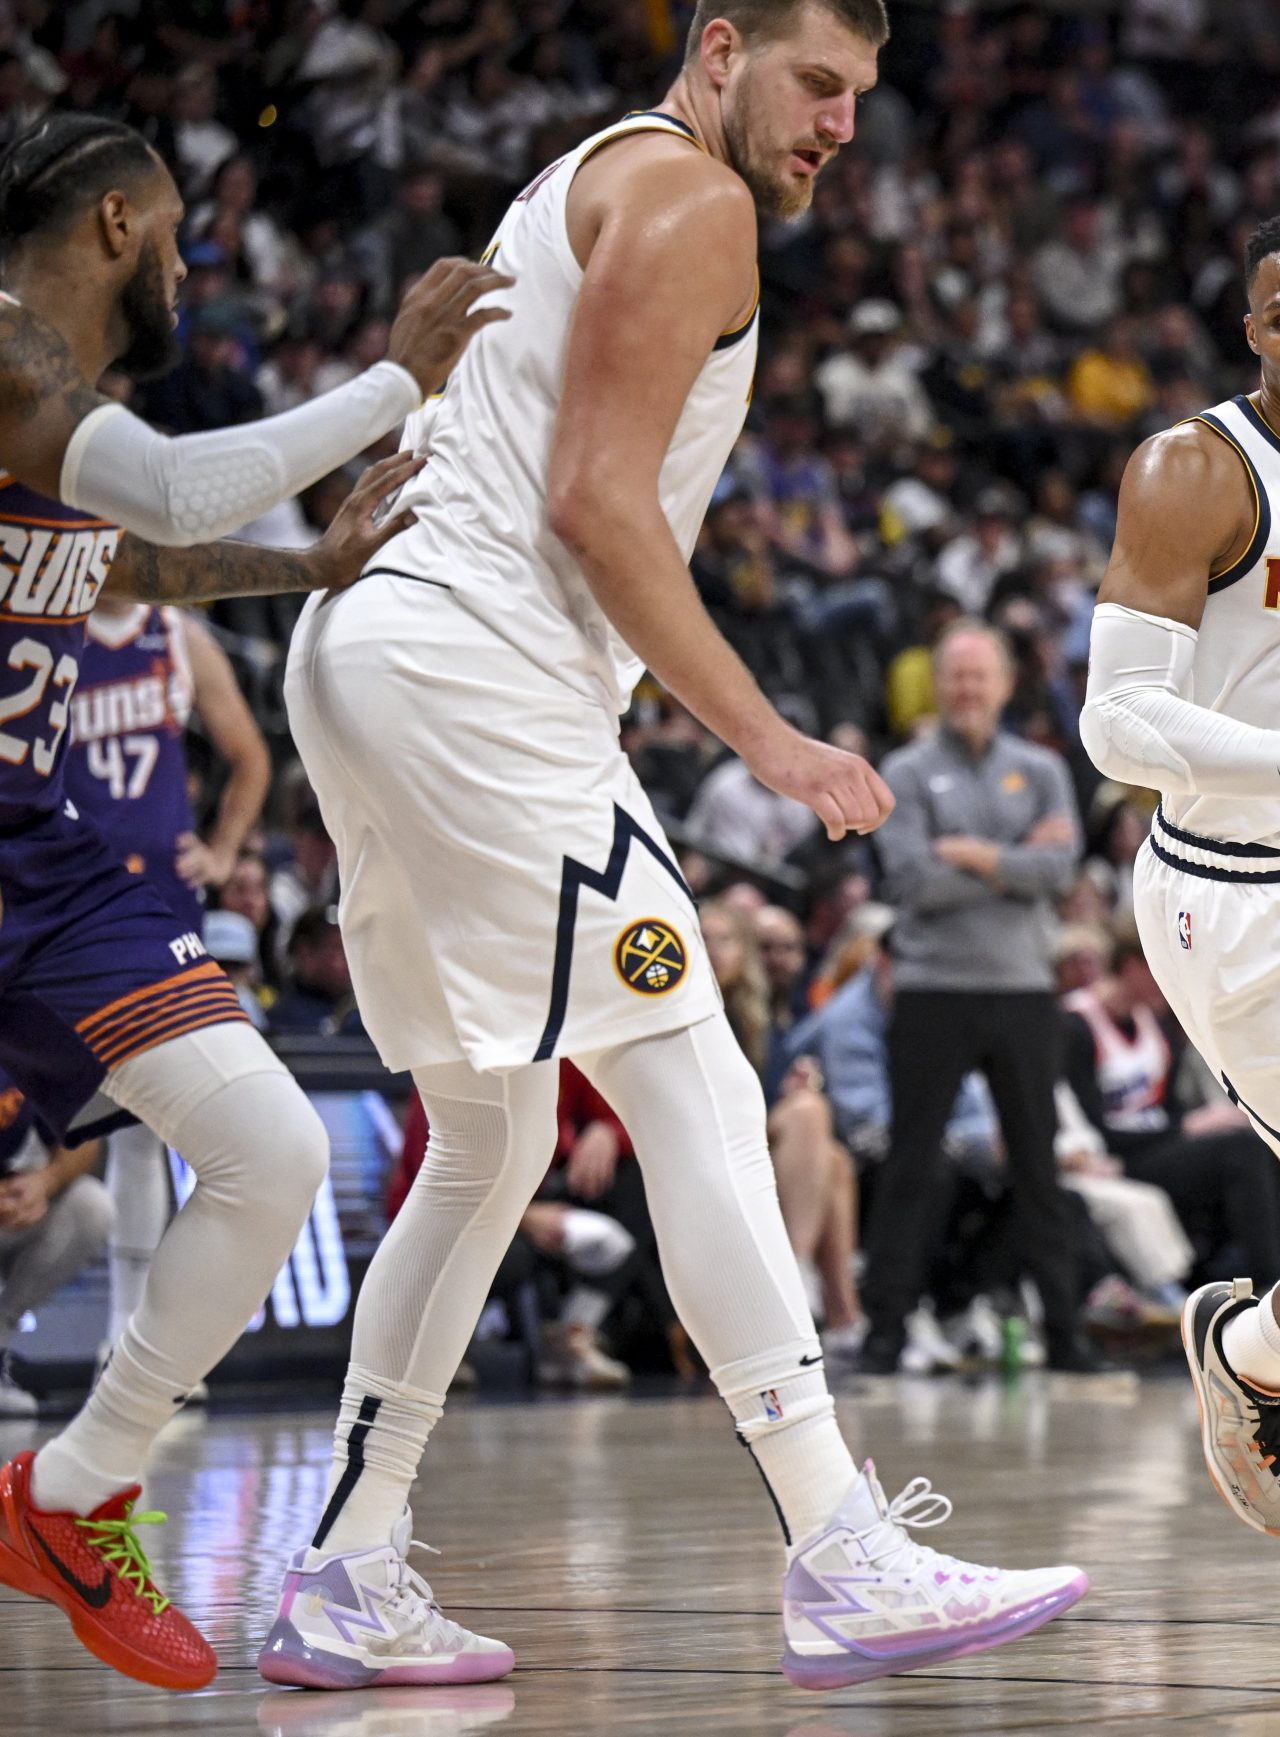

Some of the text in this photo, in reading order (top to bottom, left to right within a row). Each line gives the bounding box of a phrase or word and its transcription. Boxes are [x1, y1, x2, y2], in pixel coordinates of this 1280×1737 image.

[0, 637, 79, 777] 23
[70, 676, 166, 742] UNS
[86, 733, 160, 800] 47
[167, 931, 208, 966] PH
